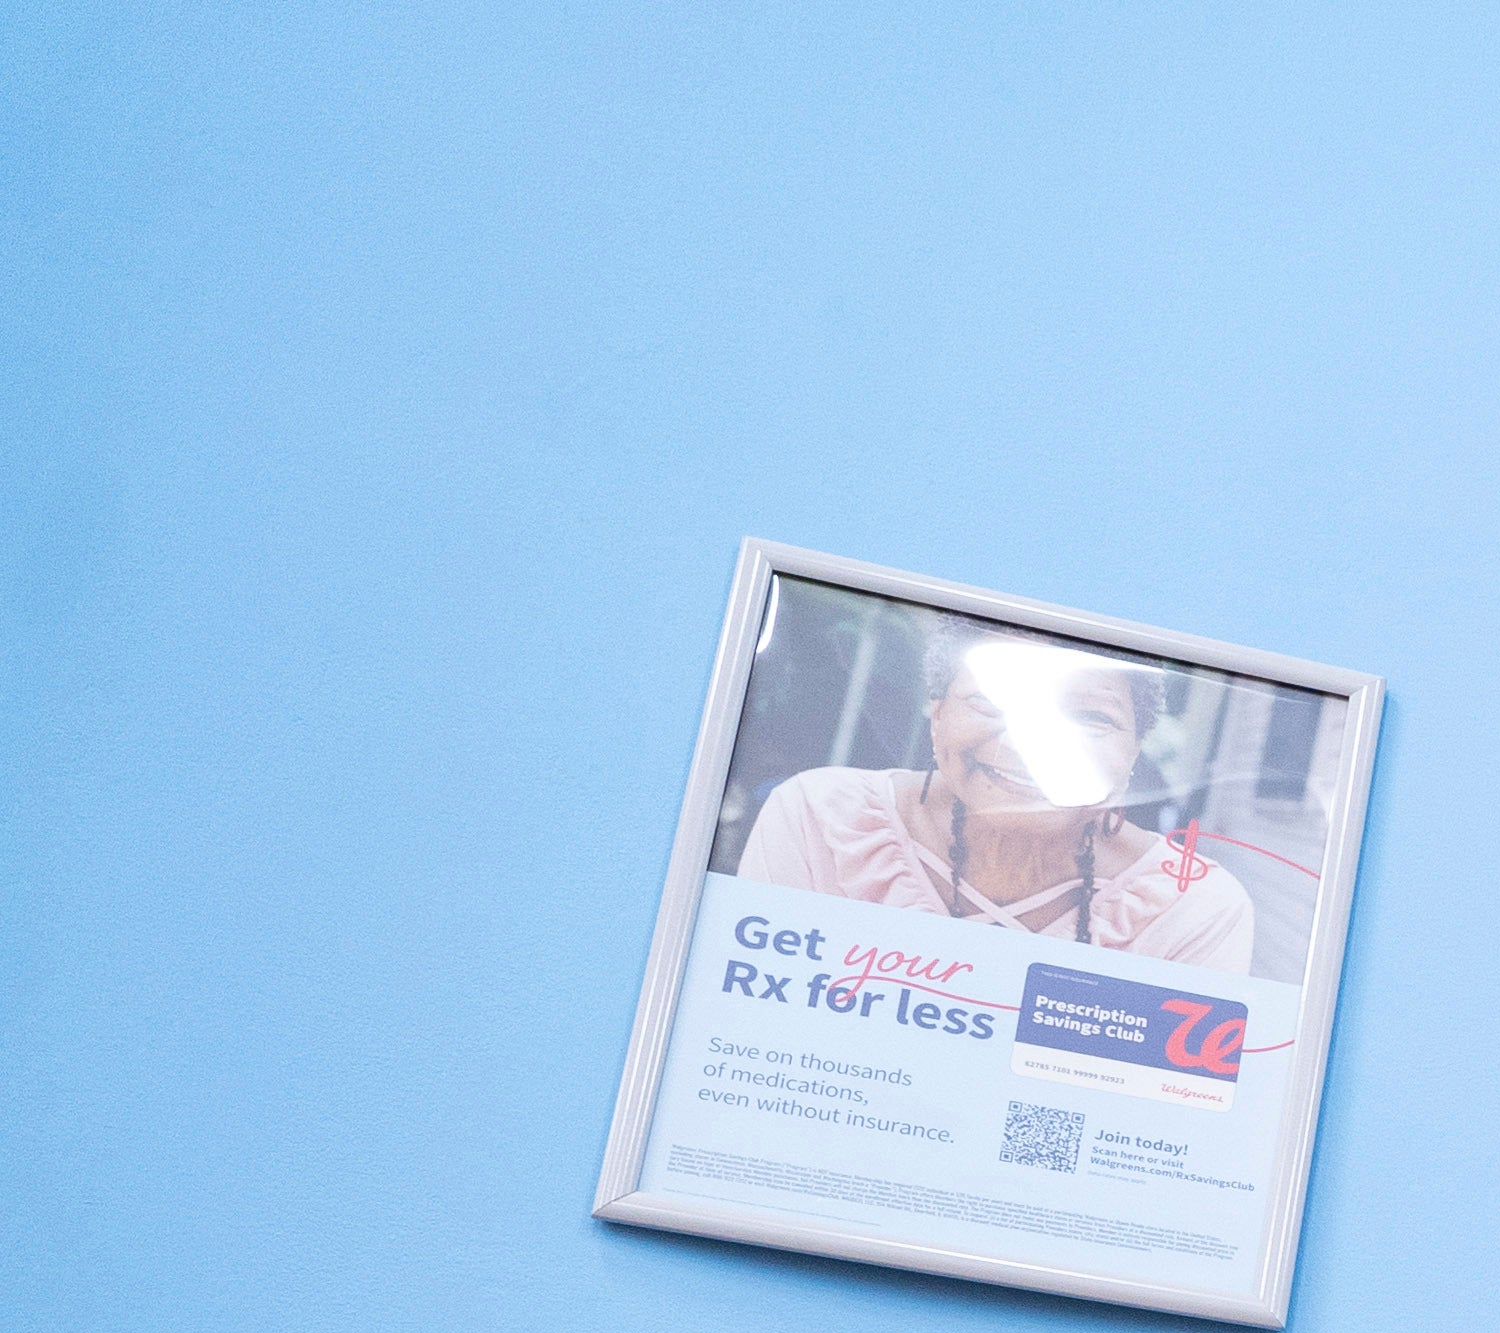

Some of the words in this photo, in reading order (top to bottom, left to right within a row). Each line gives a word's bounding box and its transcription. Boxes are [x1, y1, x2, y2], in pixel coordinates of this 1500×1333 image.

[735, 916, 825, 961] Get
[835, 944, 973, 1002] your
[722, 960, 792, 1003] Rx
[807, 973, 884, 1017] for
[896, 988, 995, 1040] less
[1035, 994, 1147, 1028] Prescription
[1033, 1011, 1101, 1036] Savings
[1105, 1025, 1145, 1043] Club
[708, 1037, 760, 1059] Save
[766, 1050, 792, 1065] on
[800, 1053, 912, 1087] thousands
[703, 1062, 727, 1078] of
[731, 1067, 868, 1105] medications,
[1161, 1083, 1224, 1103] Walgreens
[698, 1088, 749, 1107] even
[757, 1096, 840, 1123] without
[846, 1110, 954, 1143] insurance.
[1093, 1146, 1117, 1158] Scan
[1120, 1149, 1145, 1163] here
[1147, 1156, 1159, 1165] or
[1161, 1156, 1184, 1169] visit
[1094, 1129, 1130, 1146] Join
[1135, 1136, 1188, 1156] today!
[1090, 1156, 1255, 1192] Walgreens.com/RxSavingsClub
